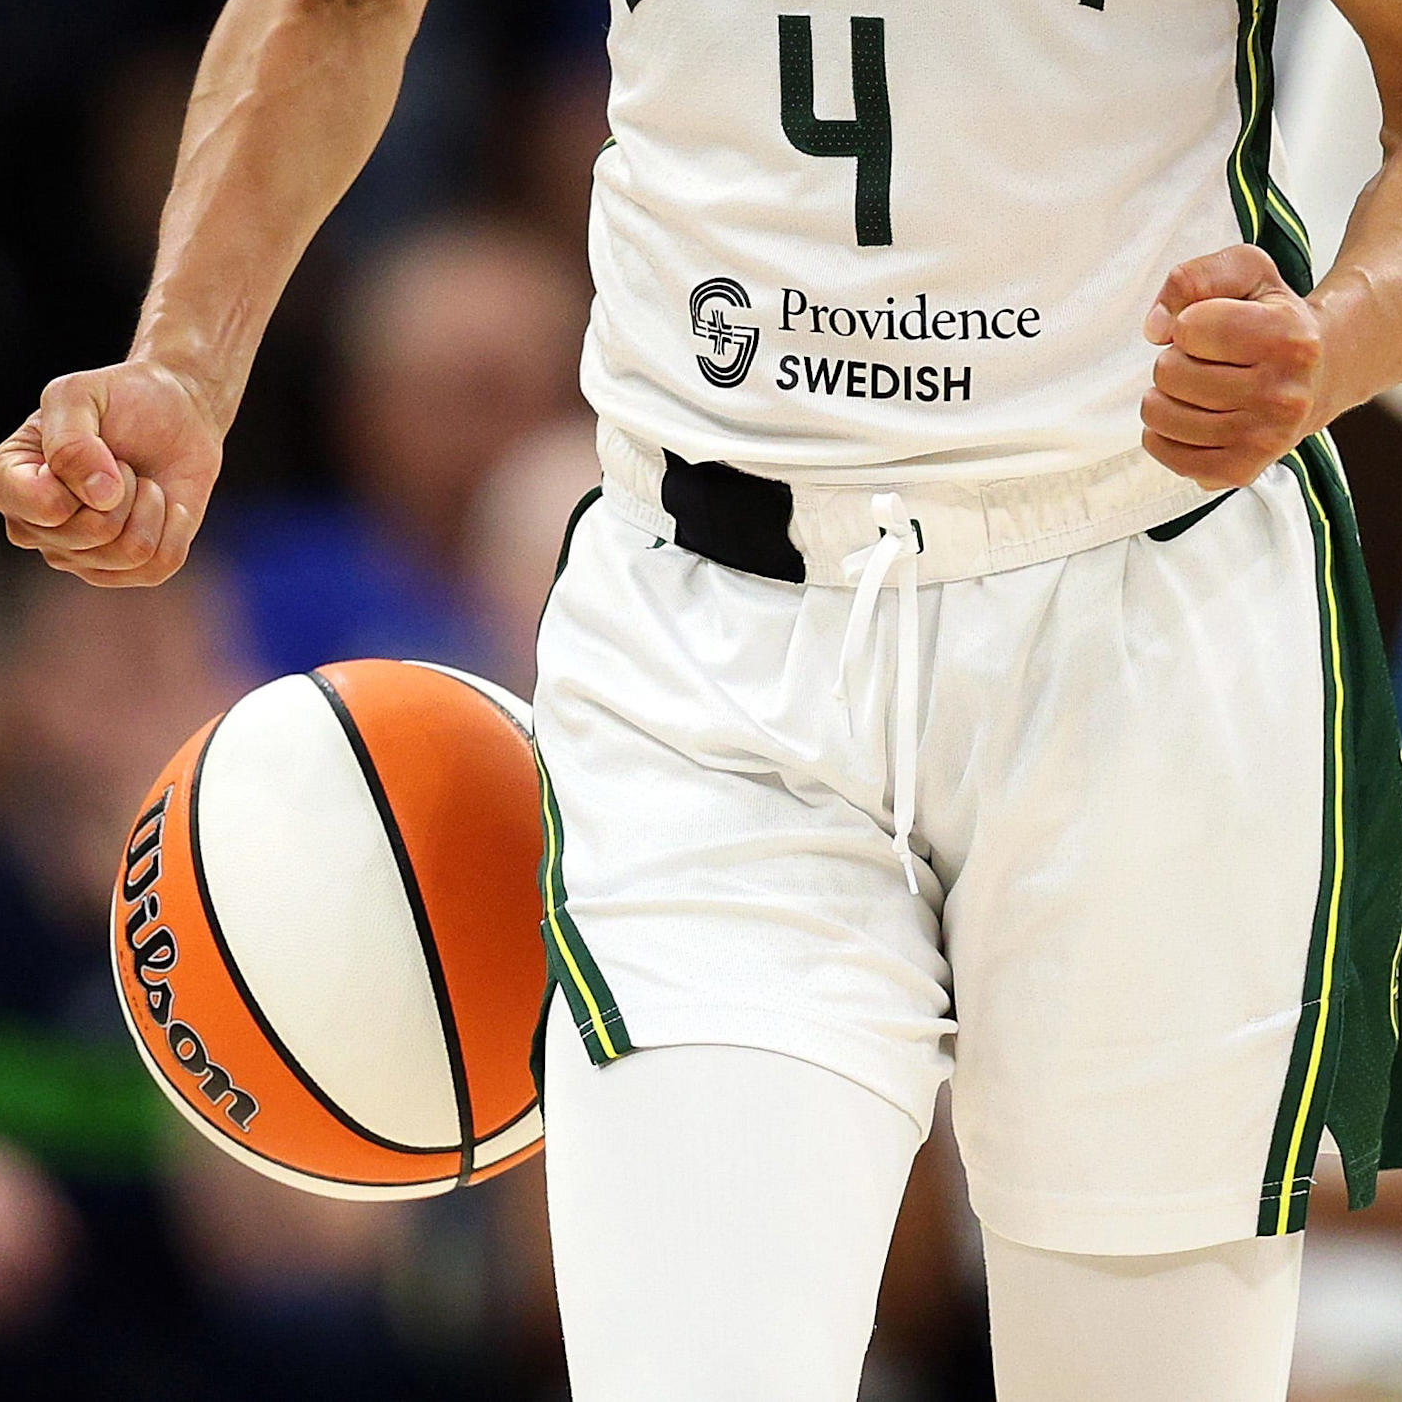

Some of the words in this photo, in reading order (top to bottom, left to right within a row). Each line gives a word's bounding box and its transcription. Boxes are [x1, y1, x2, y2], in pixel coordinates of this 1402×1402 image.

[778, 13, 893, 248] 4
[775, 354, 972, 403] SWEDISH
[778, 287, 1042, 342] Providence
[123, 783, 260, 1134] Wilson
